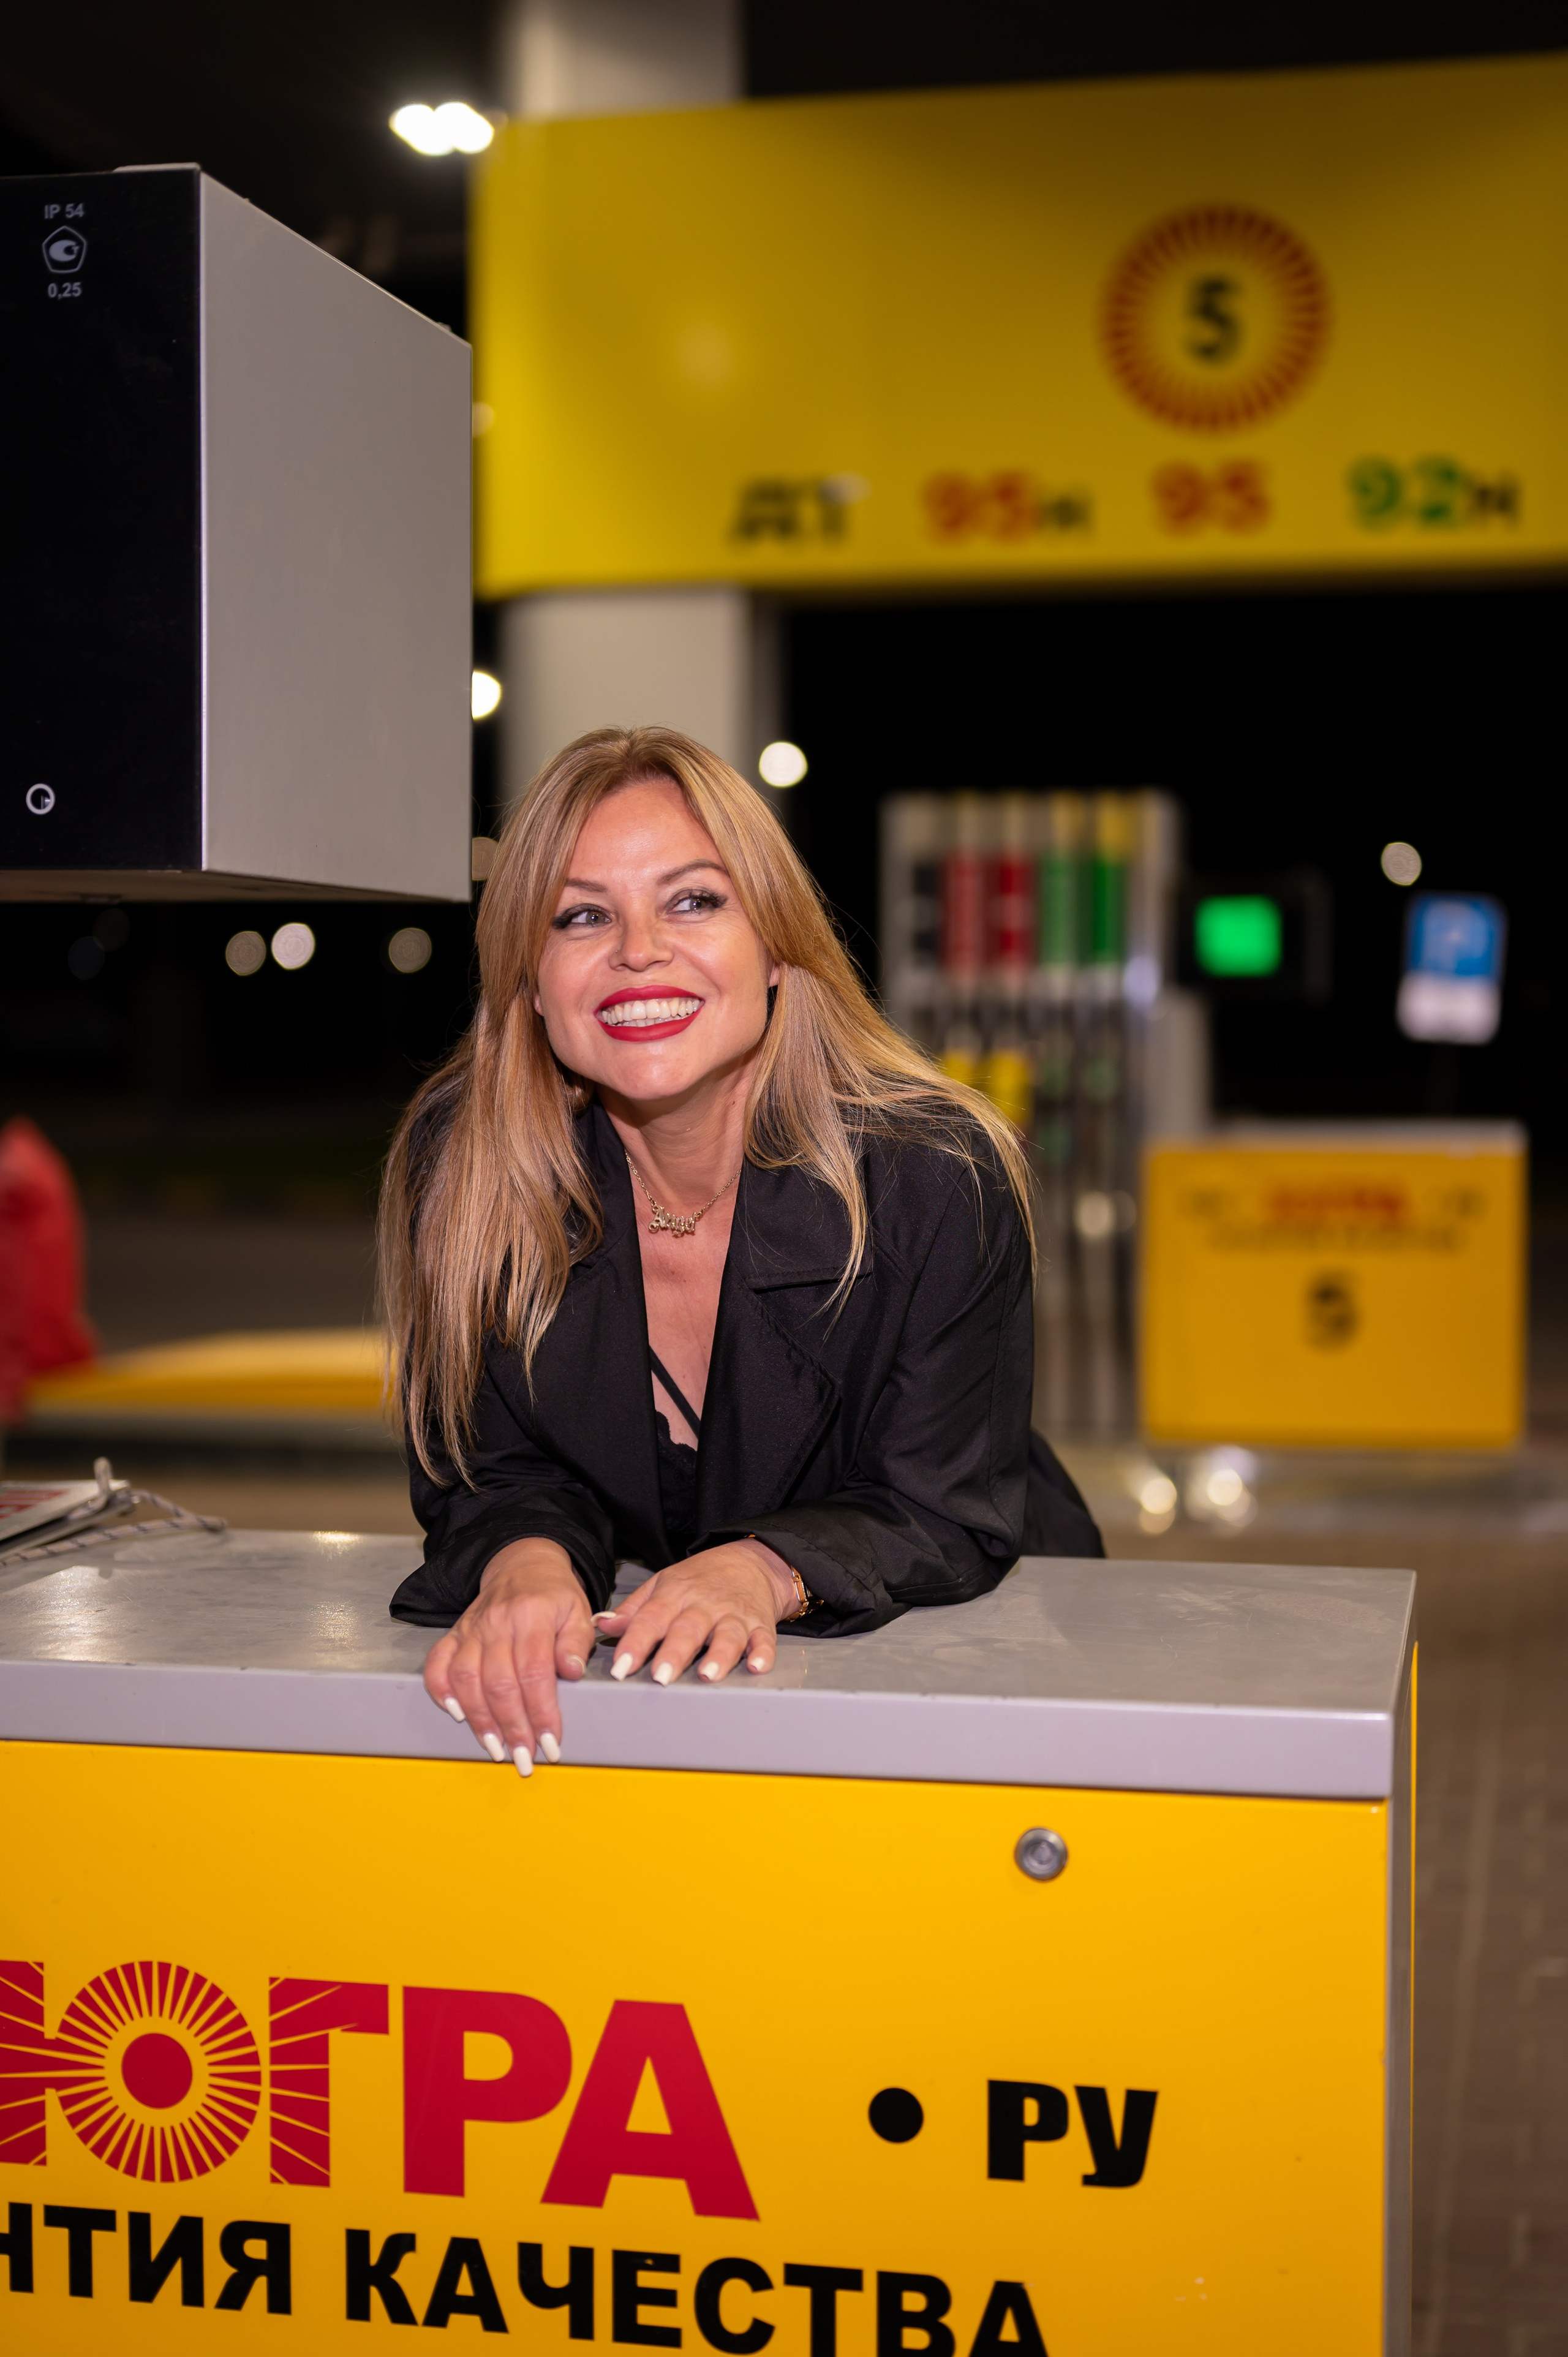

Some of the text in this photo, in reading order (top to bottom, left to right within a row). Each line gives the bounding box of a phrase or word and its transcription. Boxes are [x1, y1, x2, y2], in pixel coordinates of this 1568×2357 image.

[44, 203, 85, 219] IP 54
[48, 282, 82, 300] 0,25
[1188, 274, 1242, 368] 5
[1150, 459, 1273, 535] 95
[987, 2080, 1158, 2189] РУ
[345, 2228, 1049, 2357] КАЧЕСТВА
